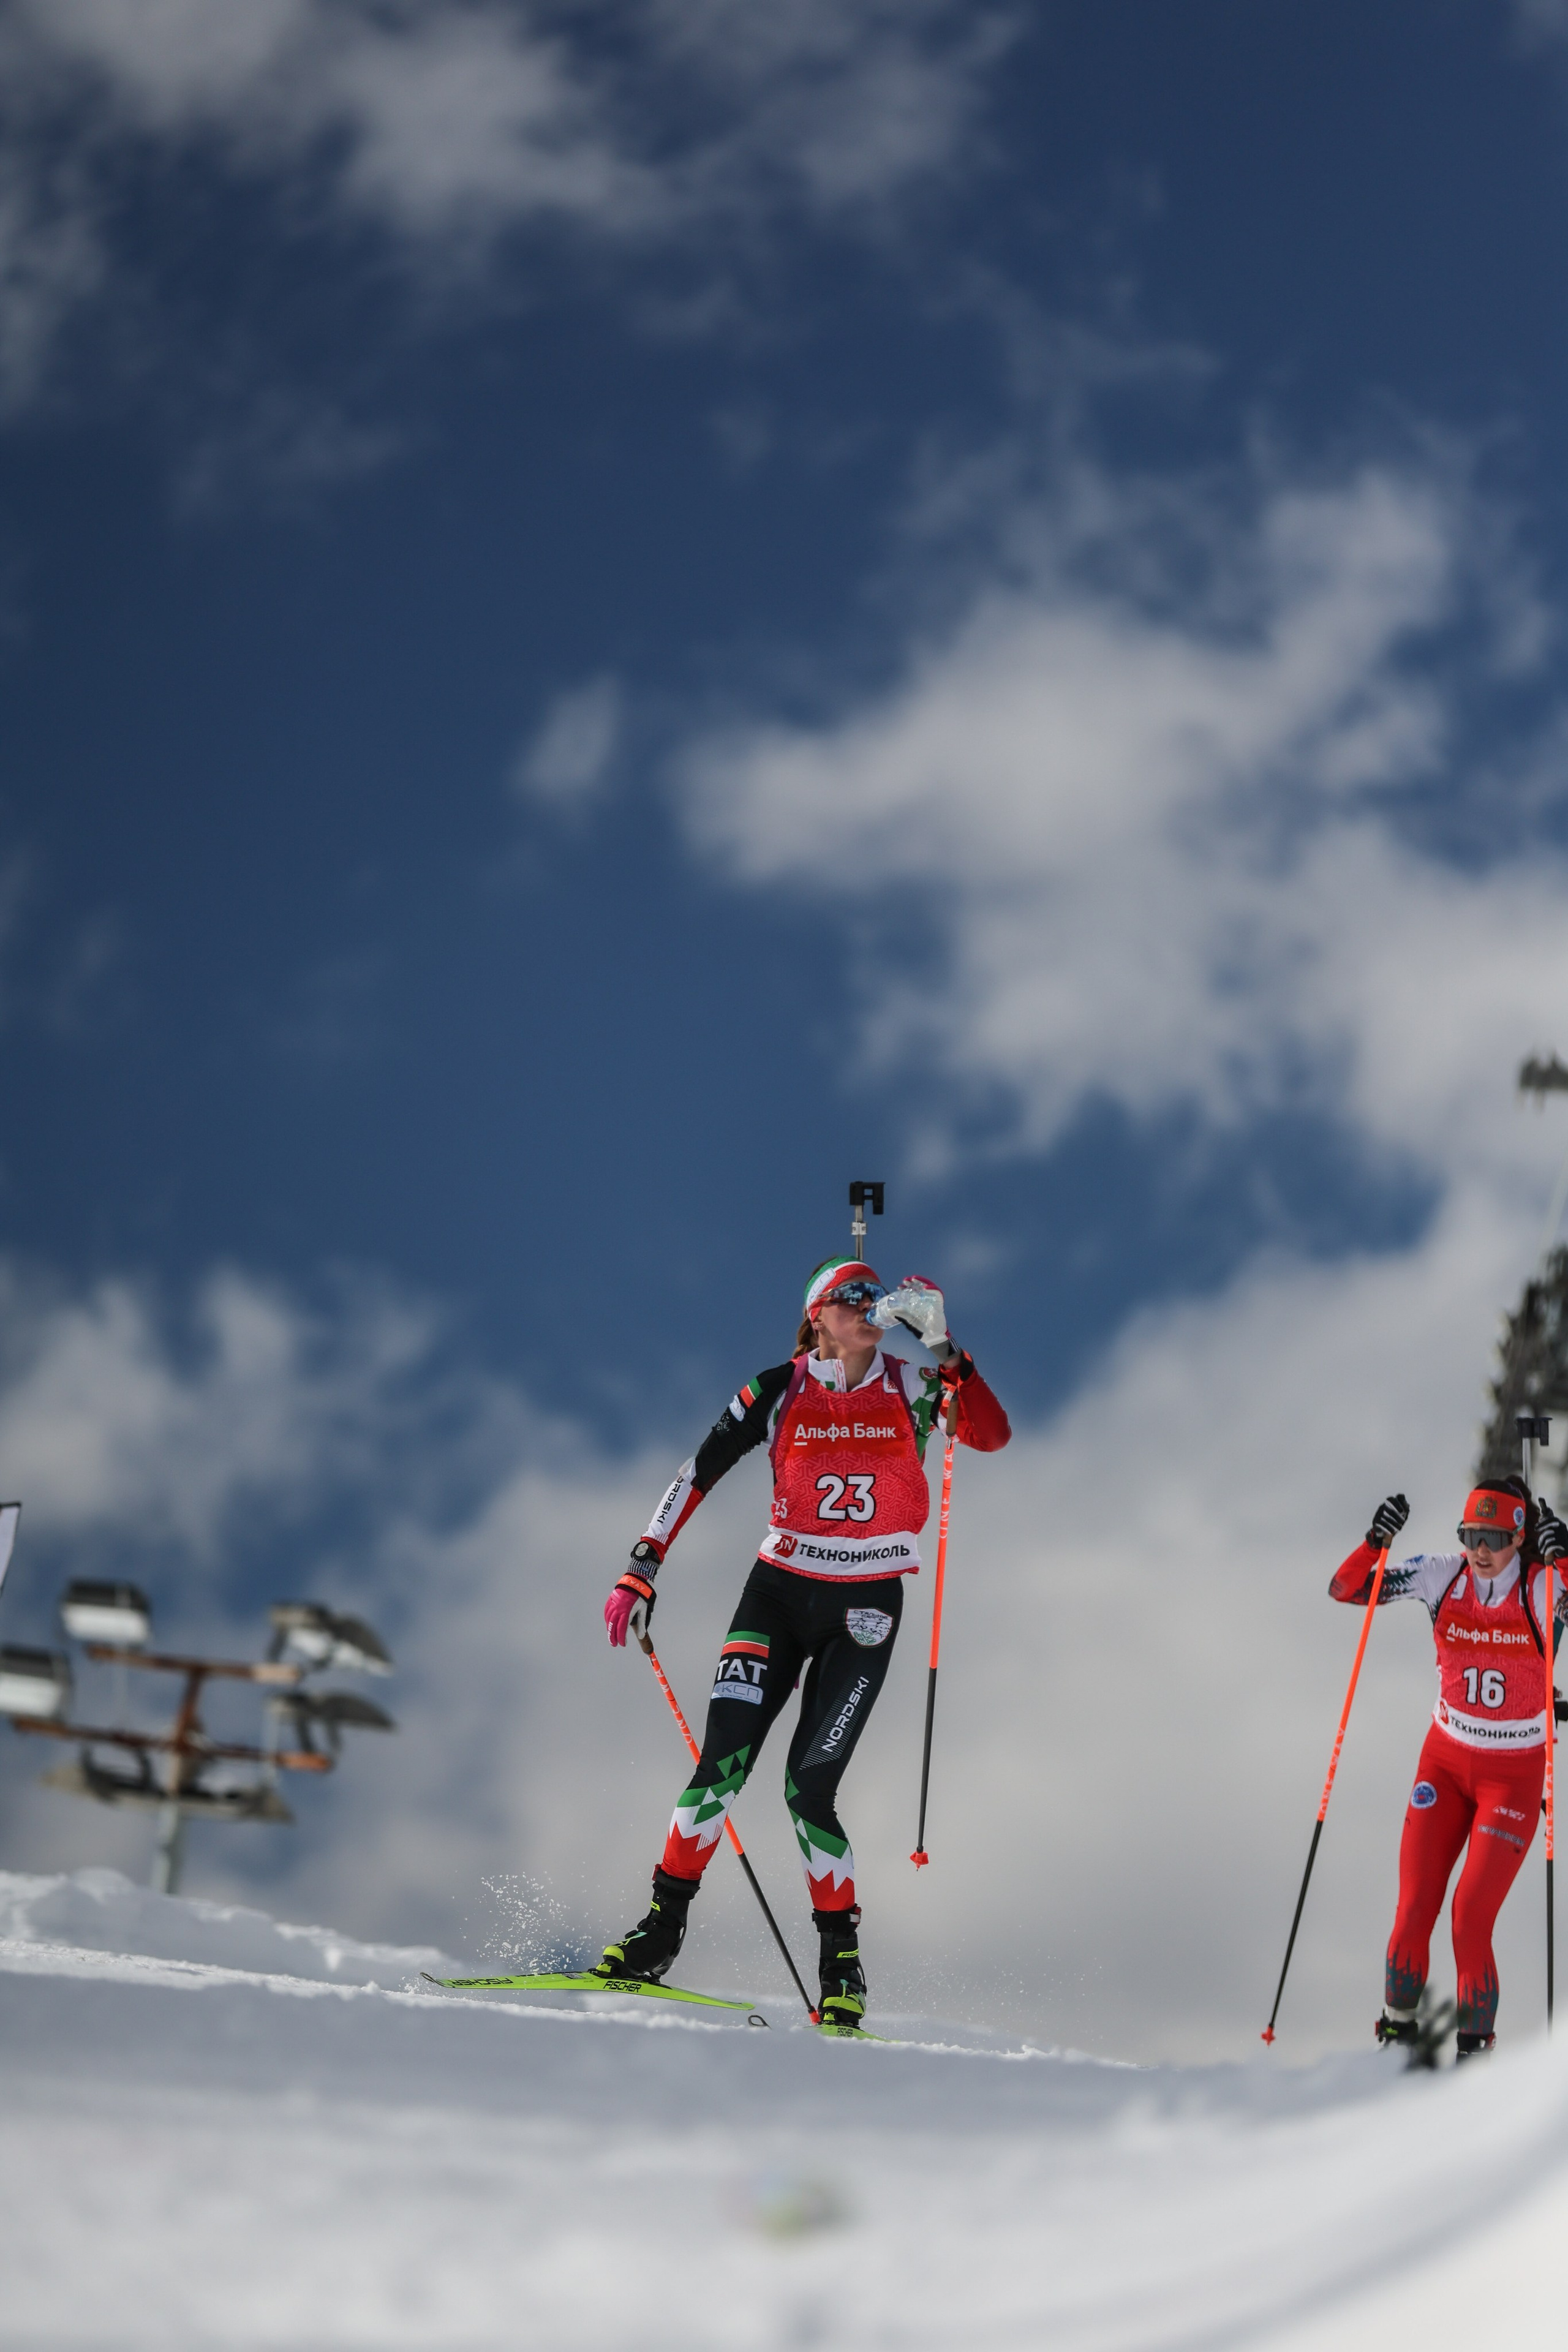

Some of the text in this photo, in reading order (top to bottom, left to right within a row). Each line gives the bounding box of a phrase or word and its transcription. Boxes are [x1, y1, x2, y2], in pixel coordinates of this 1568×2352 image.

[794, 1423, 897, 1444] Альфа Банк
[657, 1476, 684, 1523] ORDSKI
[815, 1473, 876, 1523] 23
[799, 1544, 910, 1562] ТЕХНОНИКОЛЬ
[1446, 1623, 1529, 1645] Альфа Банк
[1463, 1667, 1506, 1709] 16
[821, 1676, 869, 1752] NORDSKI
[603, 1980, 642, 1992] FISCHER
[837, 2027, 853, 2037] FISCHER
